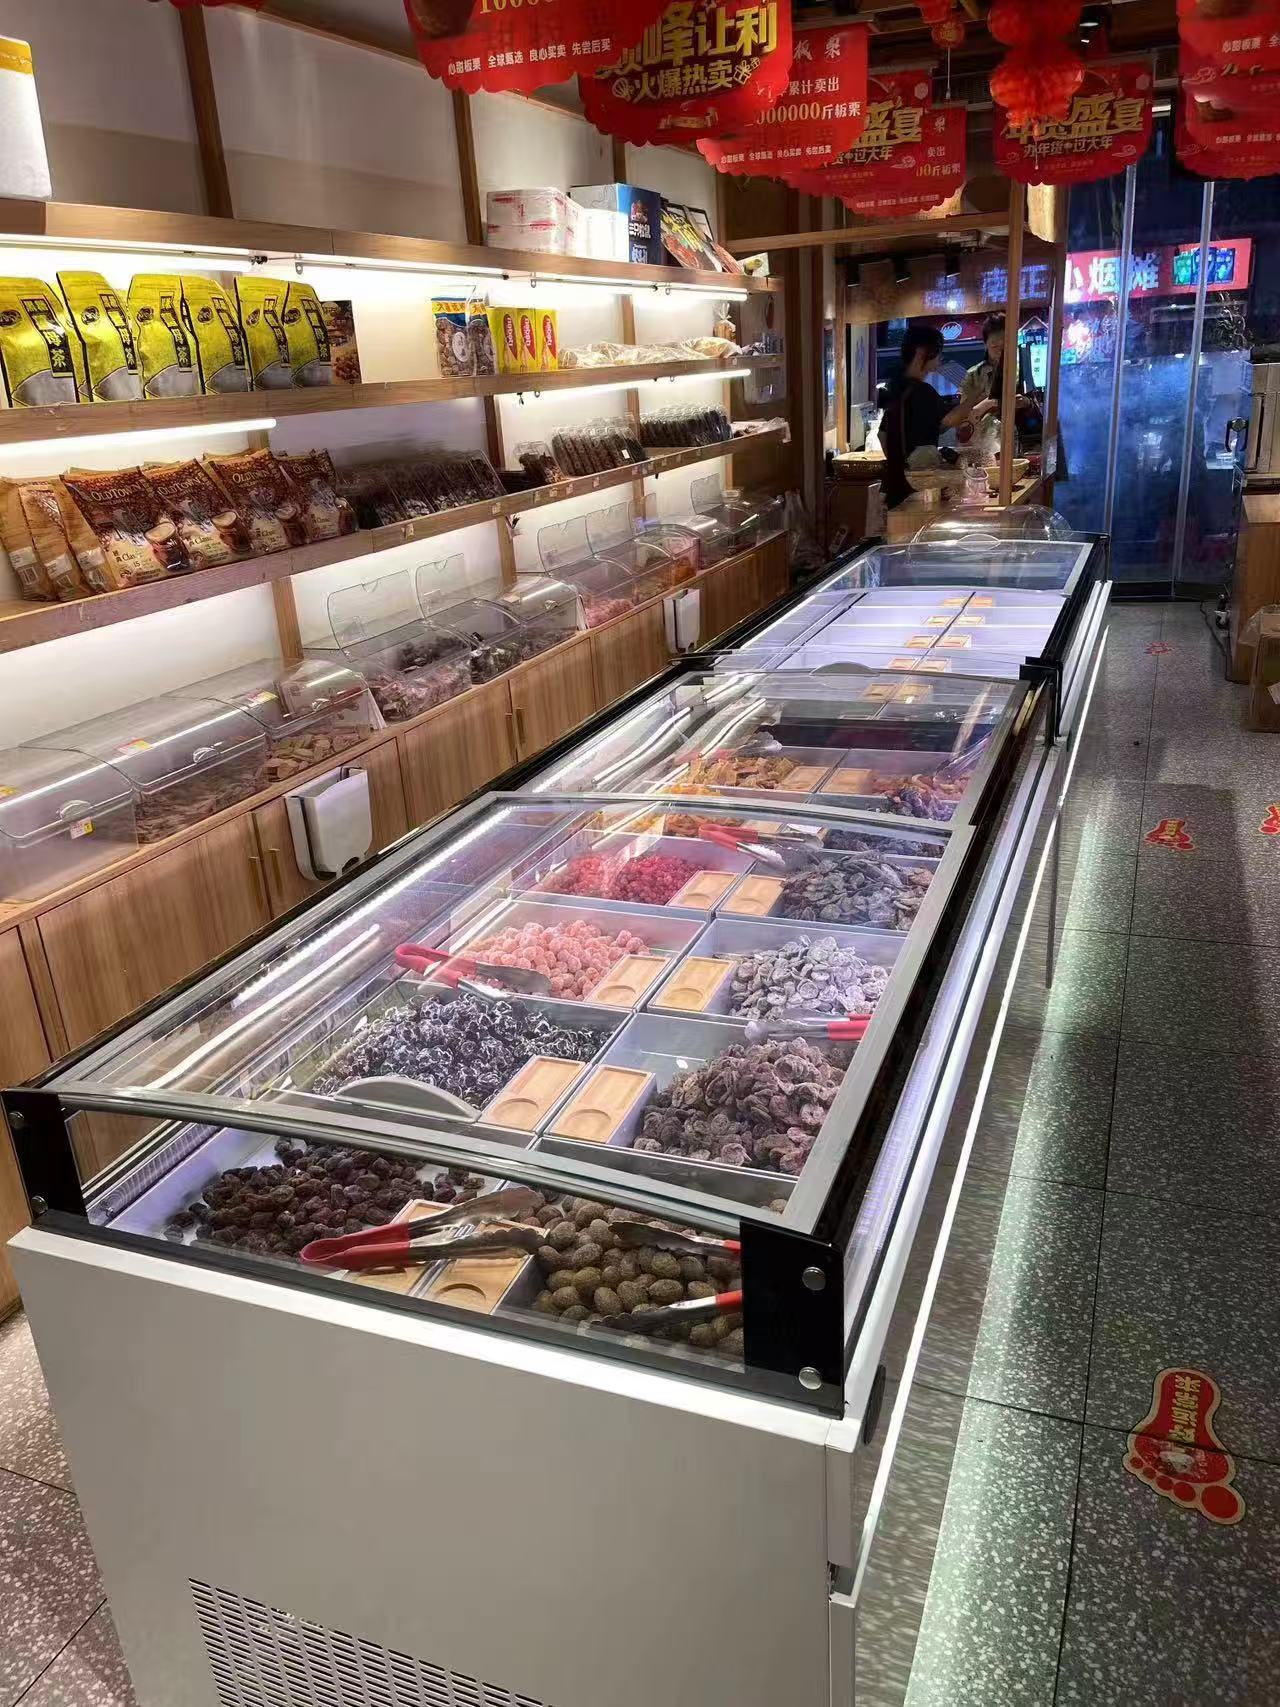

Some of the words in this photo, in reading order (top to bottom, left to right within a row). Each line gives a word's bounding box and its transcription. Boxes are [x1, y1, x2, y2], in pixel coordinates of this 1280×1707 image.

[448, 57, 481, 75] 心甜板栗
[487, 50, 524, 69] 全球甄选
[529, 44, 566, 63] 良心买卖
[571, 38, 612, 57] 先尝后买
[631, 60, 733, 104] 火爆热卖
